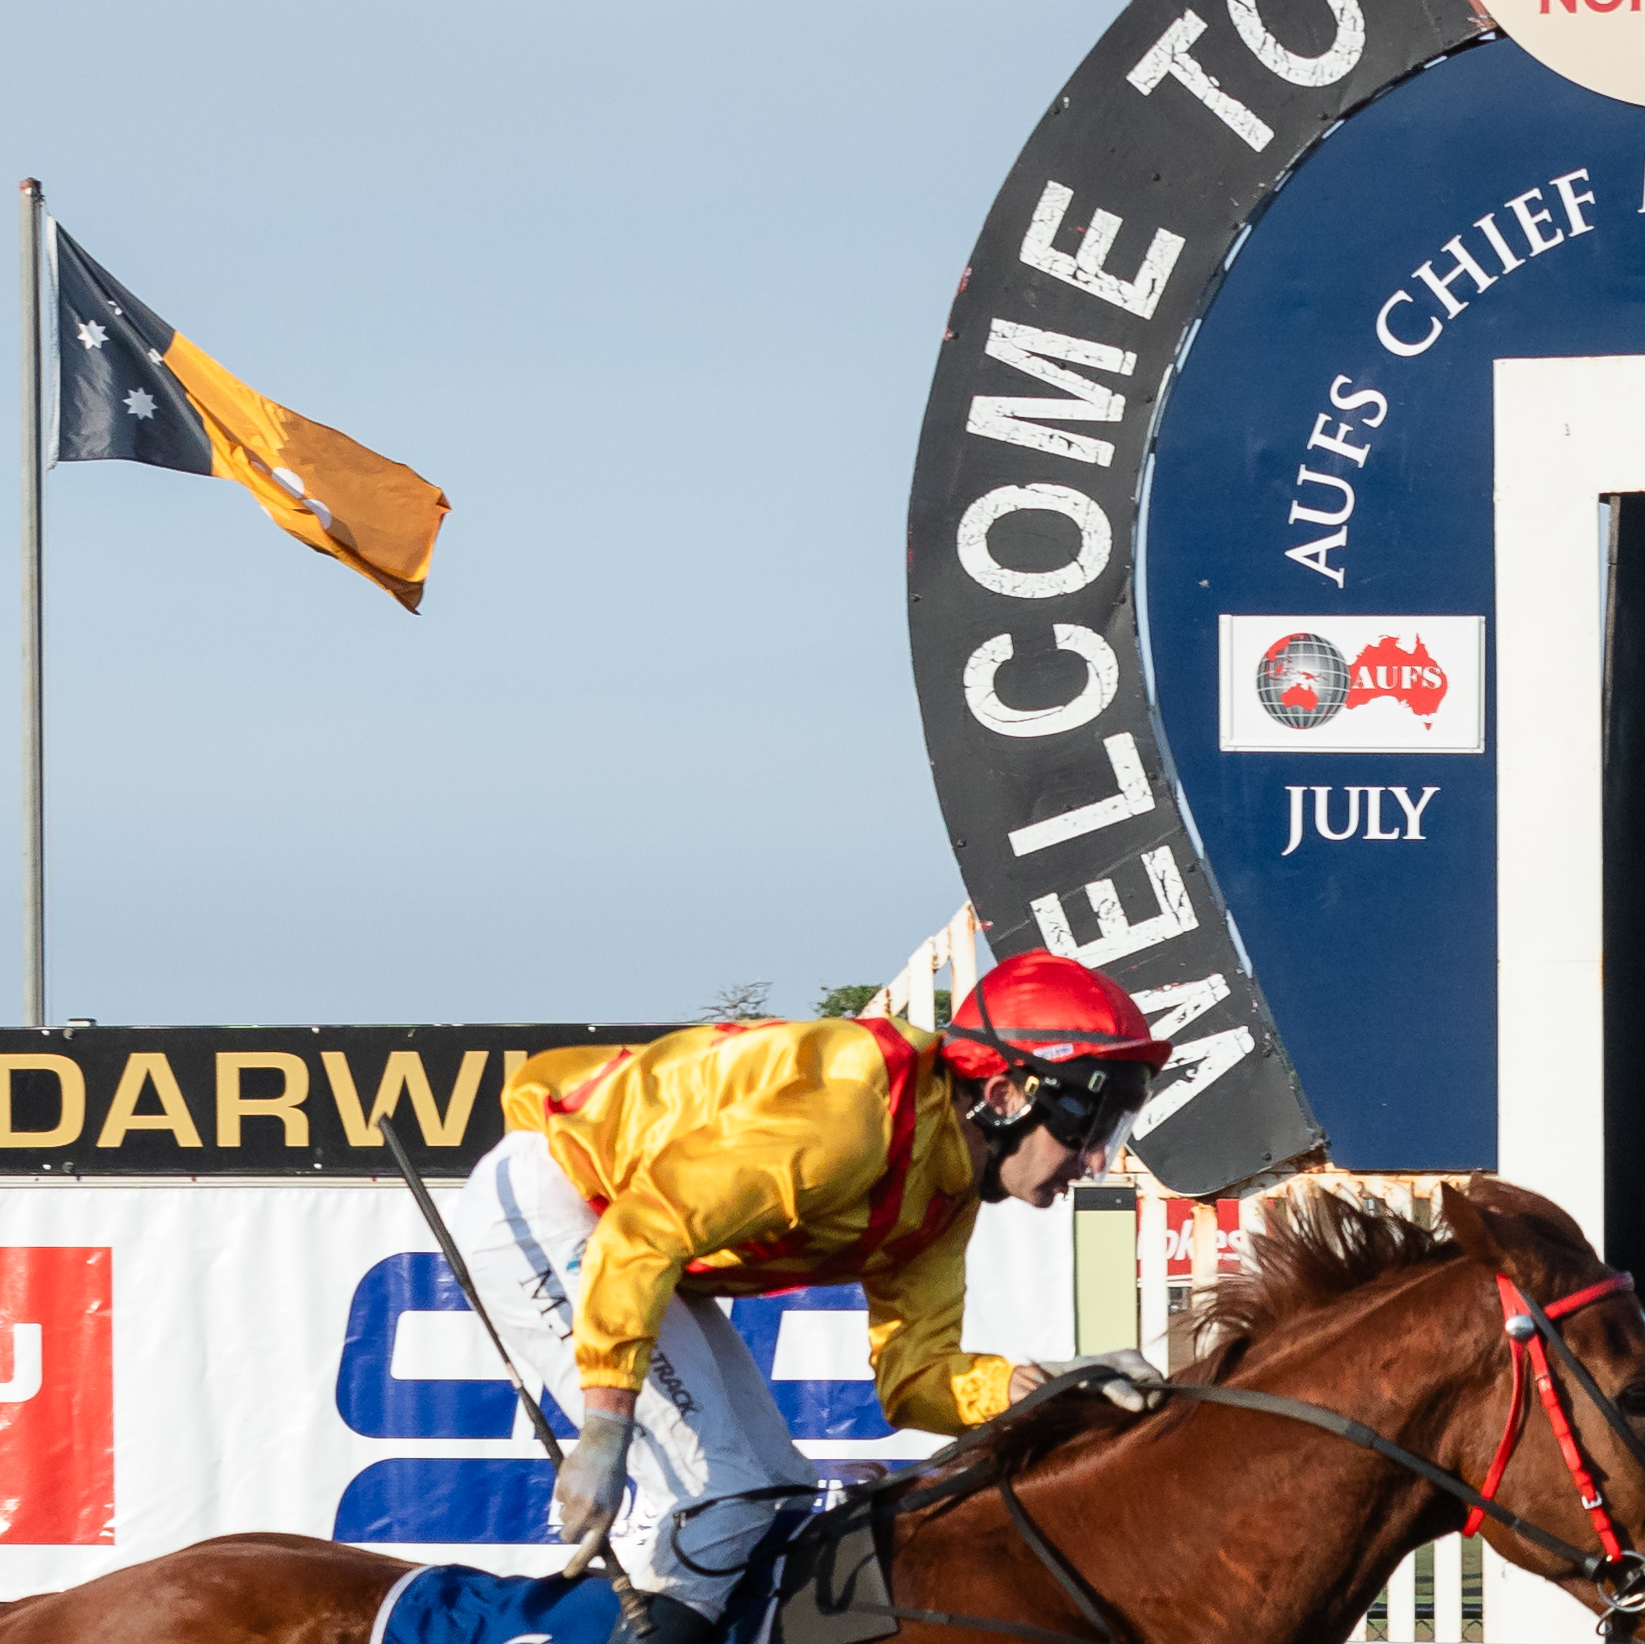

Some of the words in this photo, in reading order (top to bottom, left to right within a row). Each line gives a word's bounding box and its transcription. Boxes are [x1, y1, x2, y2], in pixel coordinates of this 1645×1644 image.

[1285, 373, 1388, 589] AUFS
[1375, 168, 1596, 359] CHIEF
[956, 180, 1255, 1141] WELCOME
[1126, 0, 1366, 153] TO
[1351, 665, 1444, 690] AUFS
[1282, 786, 1441, 856] JULY
